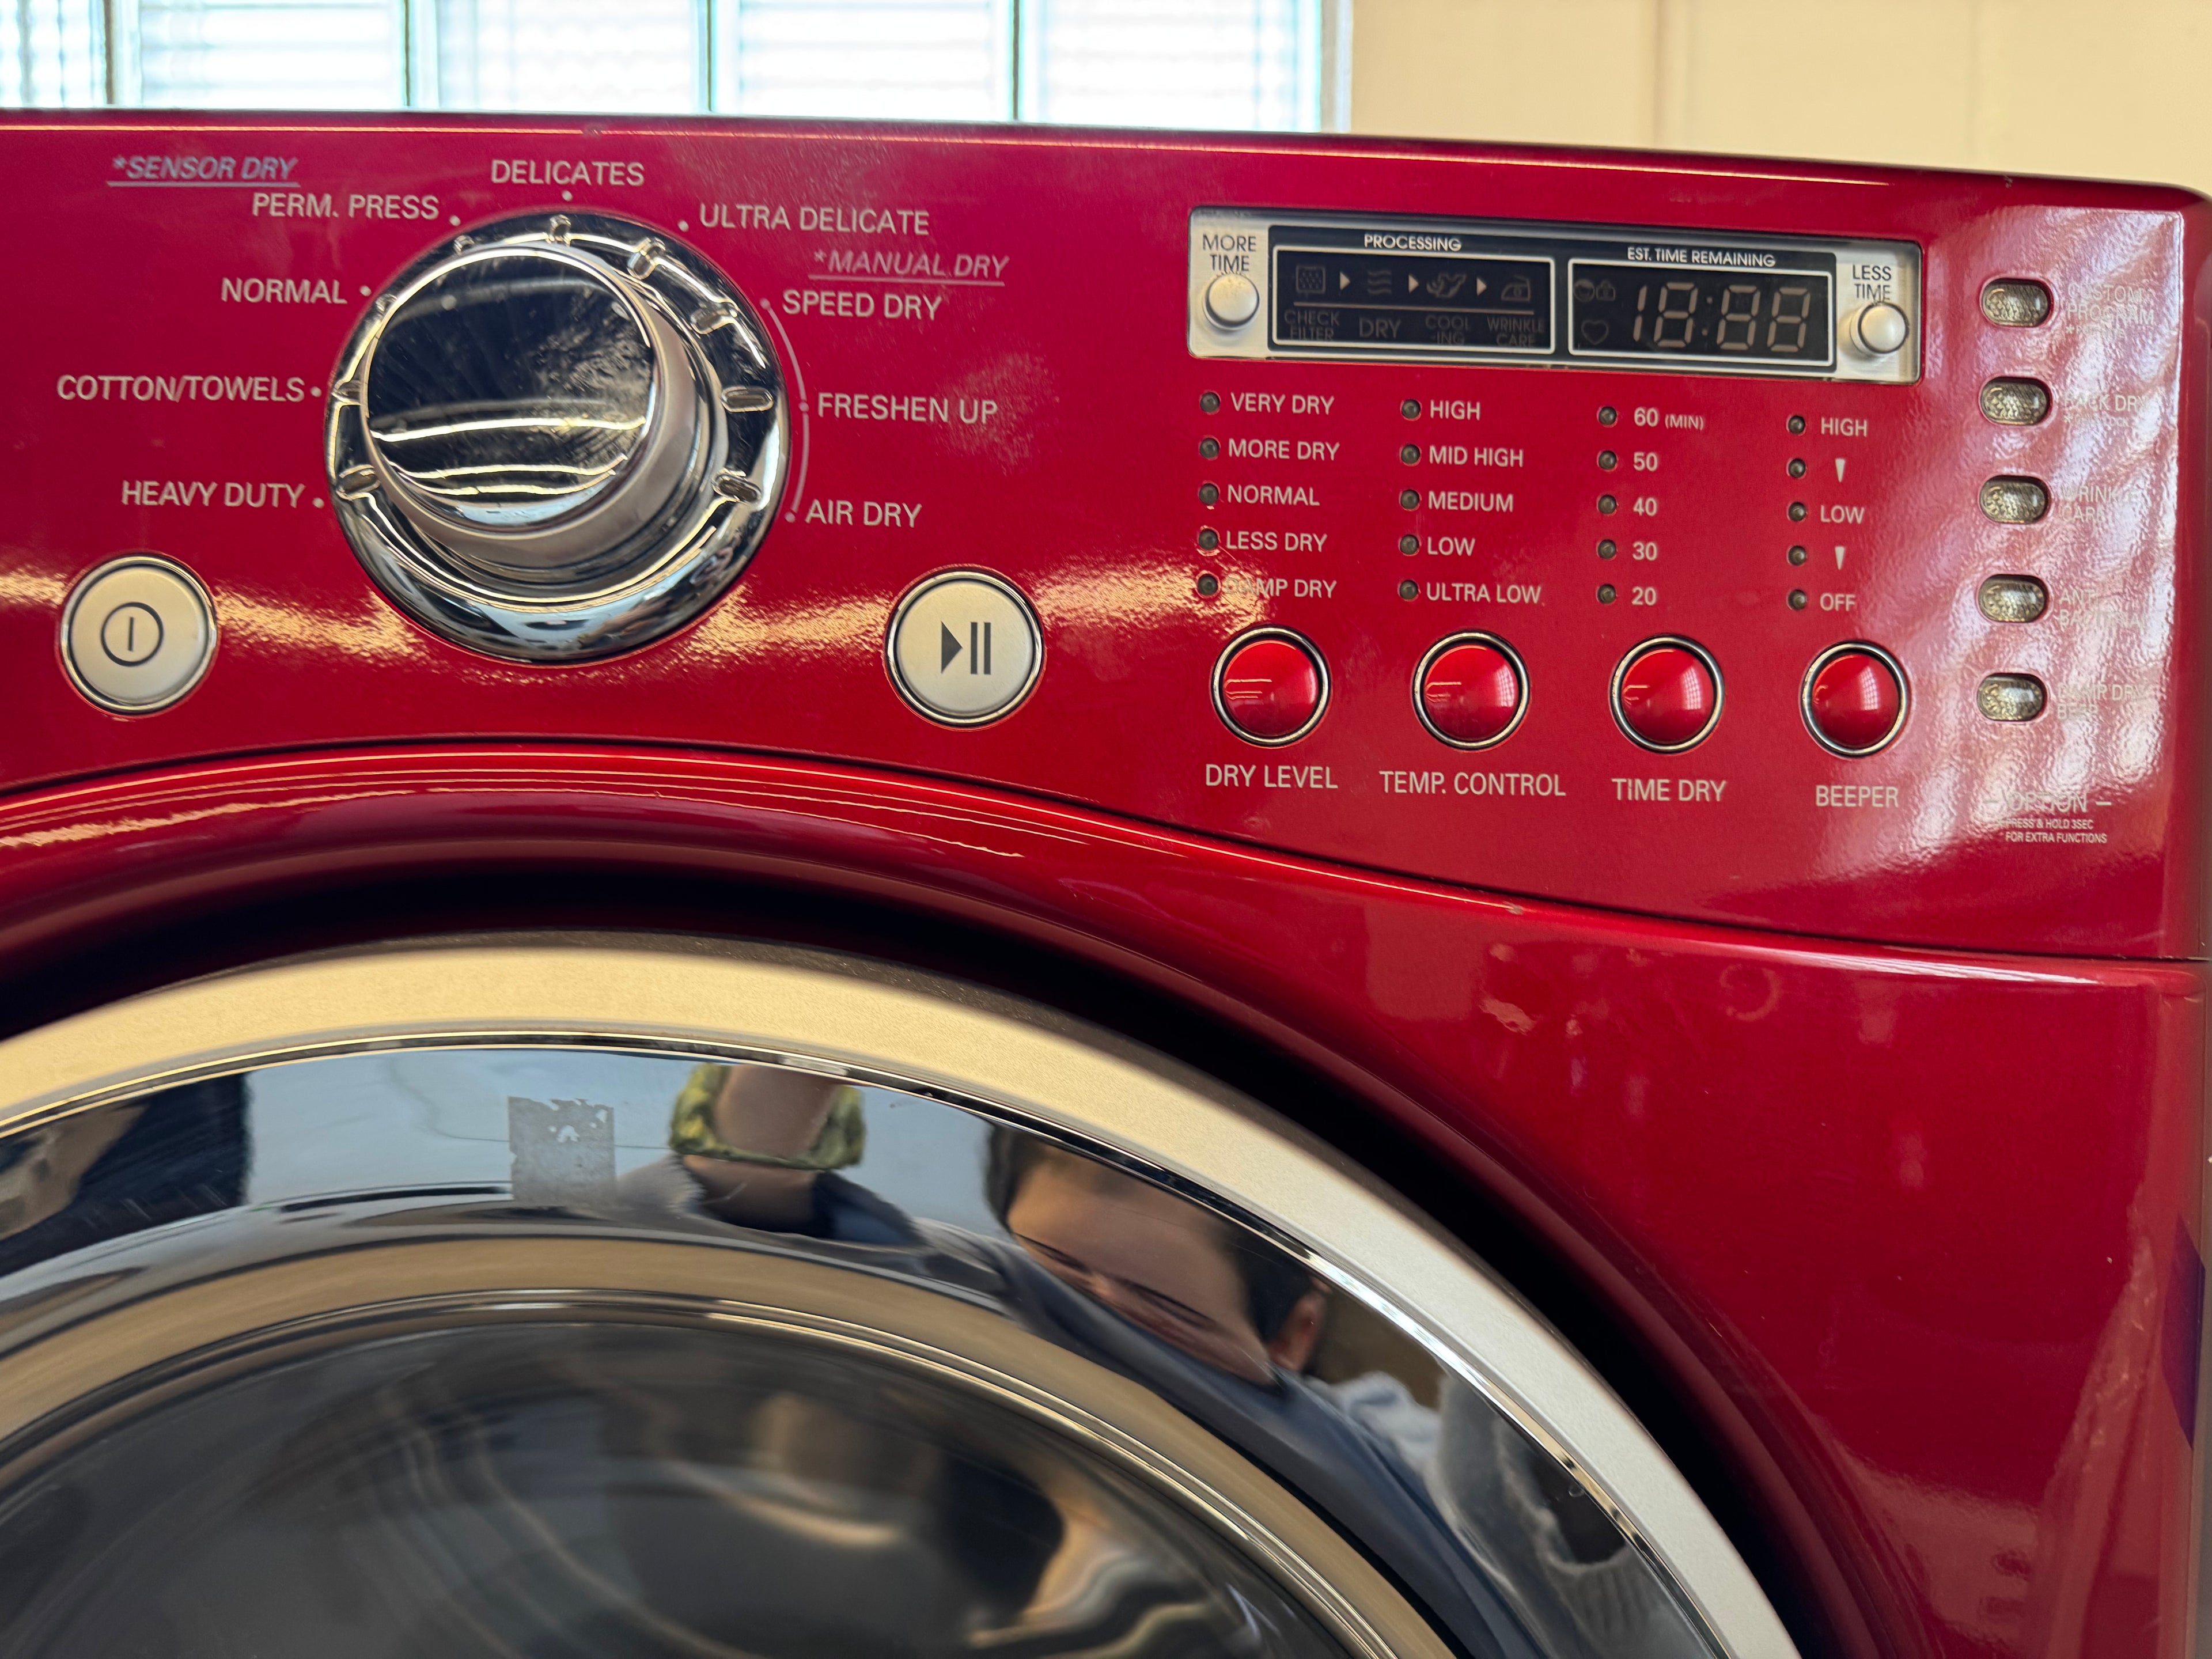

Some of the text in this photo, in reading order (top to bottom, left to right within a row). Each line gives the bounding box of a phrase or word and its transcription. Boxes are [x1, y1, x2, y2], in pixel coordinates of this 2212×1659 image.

[241, 157, 299, 182] DRY
[491, 159, 646, 187] DELICATES
[252, 193, 440, 221] PERM. PRESS
[699, 203, 930, 237] ULTRA DELICATE
[1203, 234, 1257, 252] MORE
[1364, 233, 1462, 252] PROCESSING
[956, 253, 1010, 280] DRY
[1210, 254, 1250, 272] TIME
[1627, 247, 1776, 268] EST. TIME REMAINING
[1852, 264, 1892, 282] LESS
[221, 277, 348, 305] NORMAL
[1855, 283, 1891, 302] TIME
[782, 290, 943, 322] SPEED DRY
[1284, 309, 1340, 327] CHECK
[1359, 317, 1402, 338] DRY
[1487, 316, 1544, 334] WRINKLE
[1290, 327, 1334, 342] FILTER
[1496, 333, 1536, 347] CARE
[56, 374, 305, 404] COTTON/TOWELS
[817, 392, 998, 425] FRESHEN UP
[1230, 392, 1335, 415] VERY DRY
[1430, 400, 1481, 421] HIGH
[1634, 407, 1705, 431] 60 (MIN)
[1821, 418, 1868, 438] HIGH
[1228, 438, 1340, 461] MORE DRY
[1429, 445, 1524, 468] MID HIGH
[1633, 452, 1658, 472] 50
[122, 480, 306, 509] HEAVY DUTY
[1227, 484, 1320, 507] NORMAL
[1428, 490, 1514, 513] MEDIUM
[805, 501, 923, 529] AIR DRY
[1633, 498, 1658, 517] 40
[1820, 505, 1865, 525] LOW
[1226, 531, 1328, 552] LESS DRY
[1427, 536, 1476, 556] LOW
[1633, 541, 1658, 562] 30
[1294, 578, 1338, 599] DRY
[1426, 582, 1542, 605] ULTRA LOW
[1631, 586, 1658, 607] 20
[1820, 593, 1856, 612] OFF
[1205, 763, 1339, 790] DRY LEVEL
[1380, 771, 1566, 798] TEMP. CONTROL
[1612, 777, 1728, 804] TIME DRY
[1815, 785, 1899, 808] BEEPER
[2036, 819, 2044, 828] &
[2046, 819, 2070, 830] HOLD
[2005, 831, 2108, 844] FOR EXTRA FUNCTIONS
